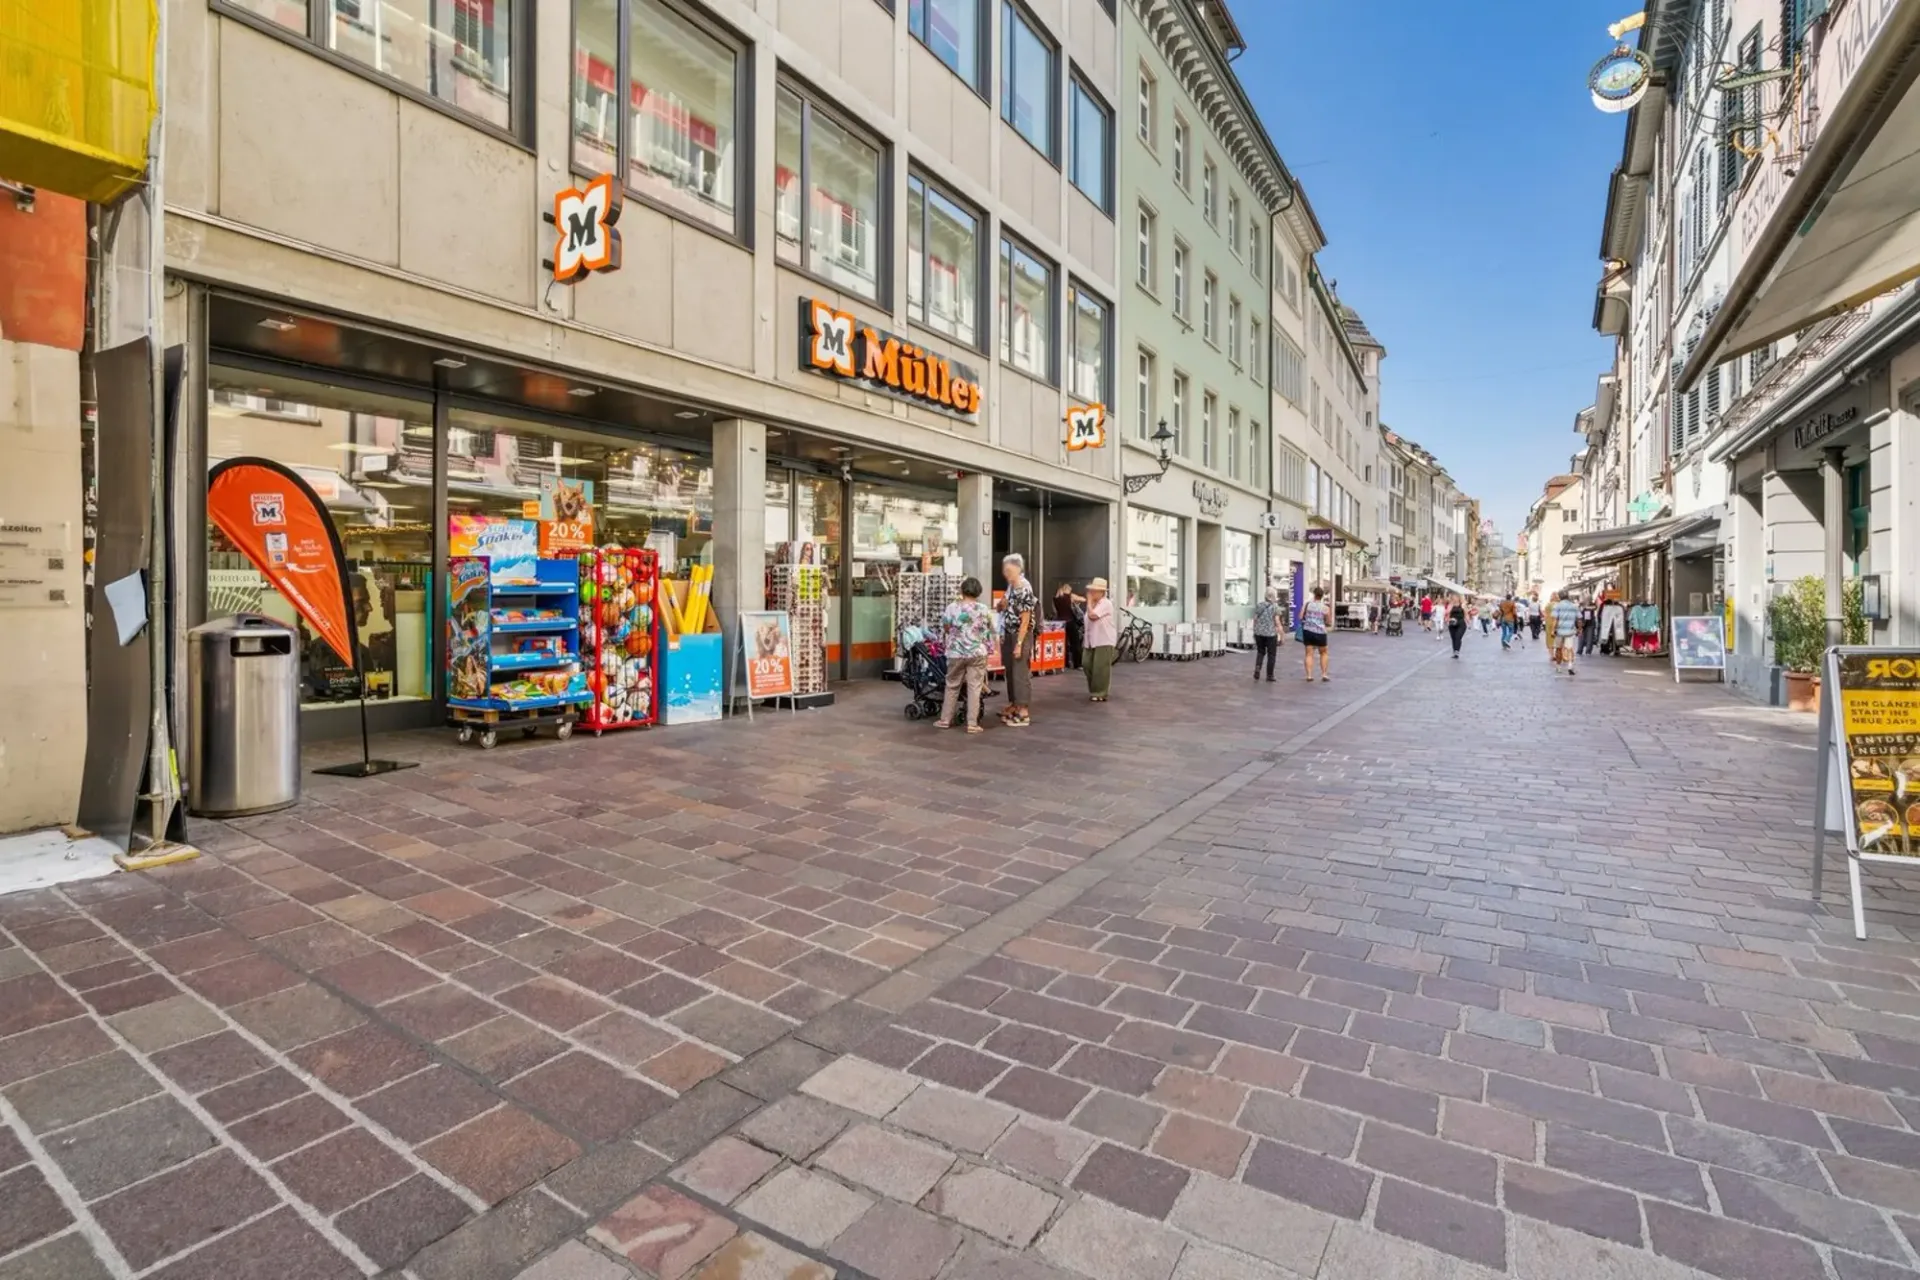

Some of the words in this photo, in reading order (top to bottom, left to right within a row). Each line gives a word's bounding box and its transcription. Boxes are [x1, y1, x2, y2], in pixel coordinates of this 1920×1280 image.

[567, 205, 598, 252] M
[823, 323, 846, 356] M
[863, 322, 985, 414] Müller
[1076, 417, 1095, 437] M
[261, 507, 276, 518] M
[549, 522, 568, 538] 20
[570, 524, 585, 540] %
[754, 659, 770, 674] 20
[770, 658, 784, 673] %
[1850, 700, 1869, 708] EIN
[1851, 708, 1887, 716] START
[1890, 709, 1909, 717] INS
